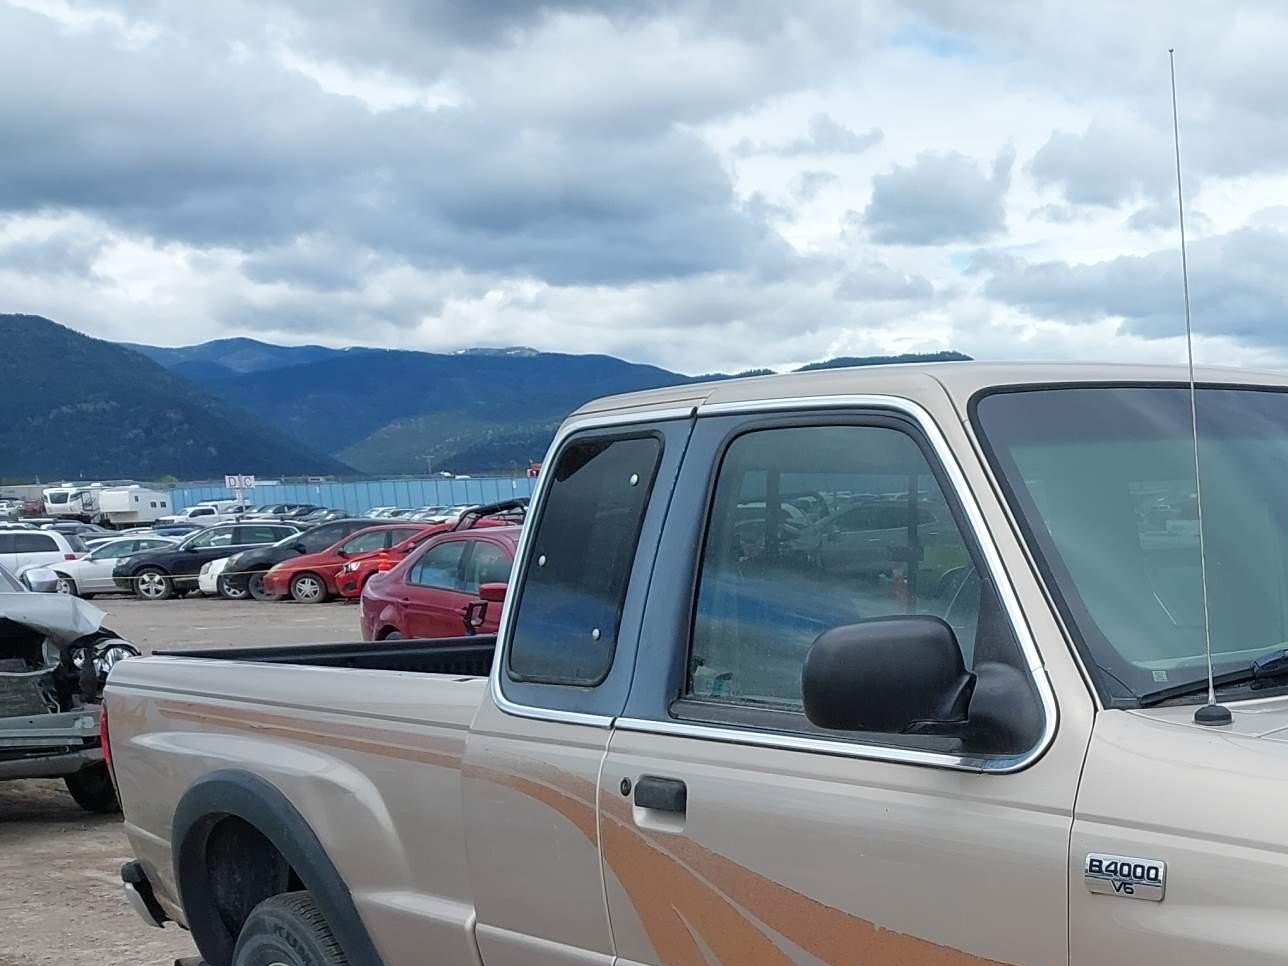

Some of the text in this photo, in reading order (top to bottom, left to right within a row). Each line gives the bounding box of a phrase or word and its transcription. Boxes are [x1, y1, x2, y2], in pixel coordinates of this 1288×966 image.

[228, 476, 237, 487] D
[1088, 858, 1160, 882] B4000
[1111, 880, 1135, 895] V6
